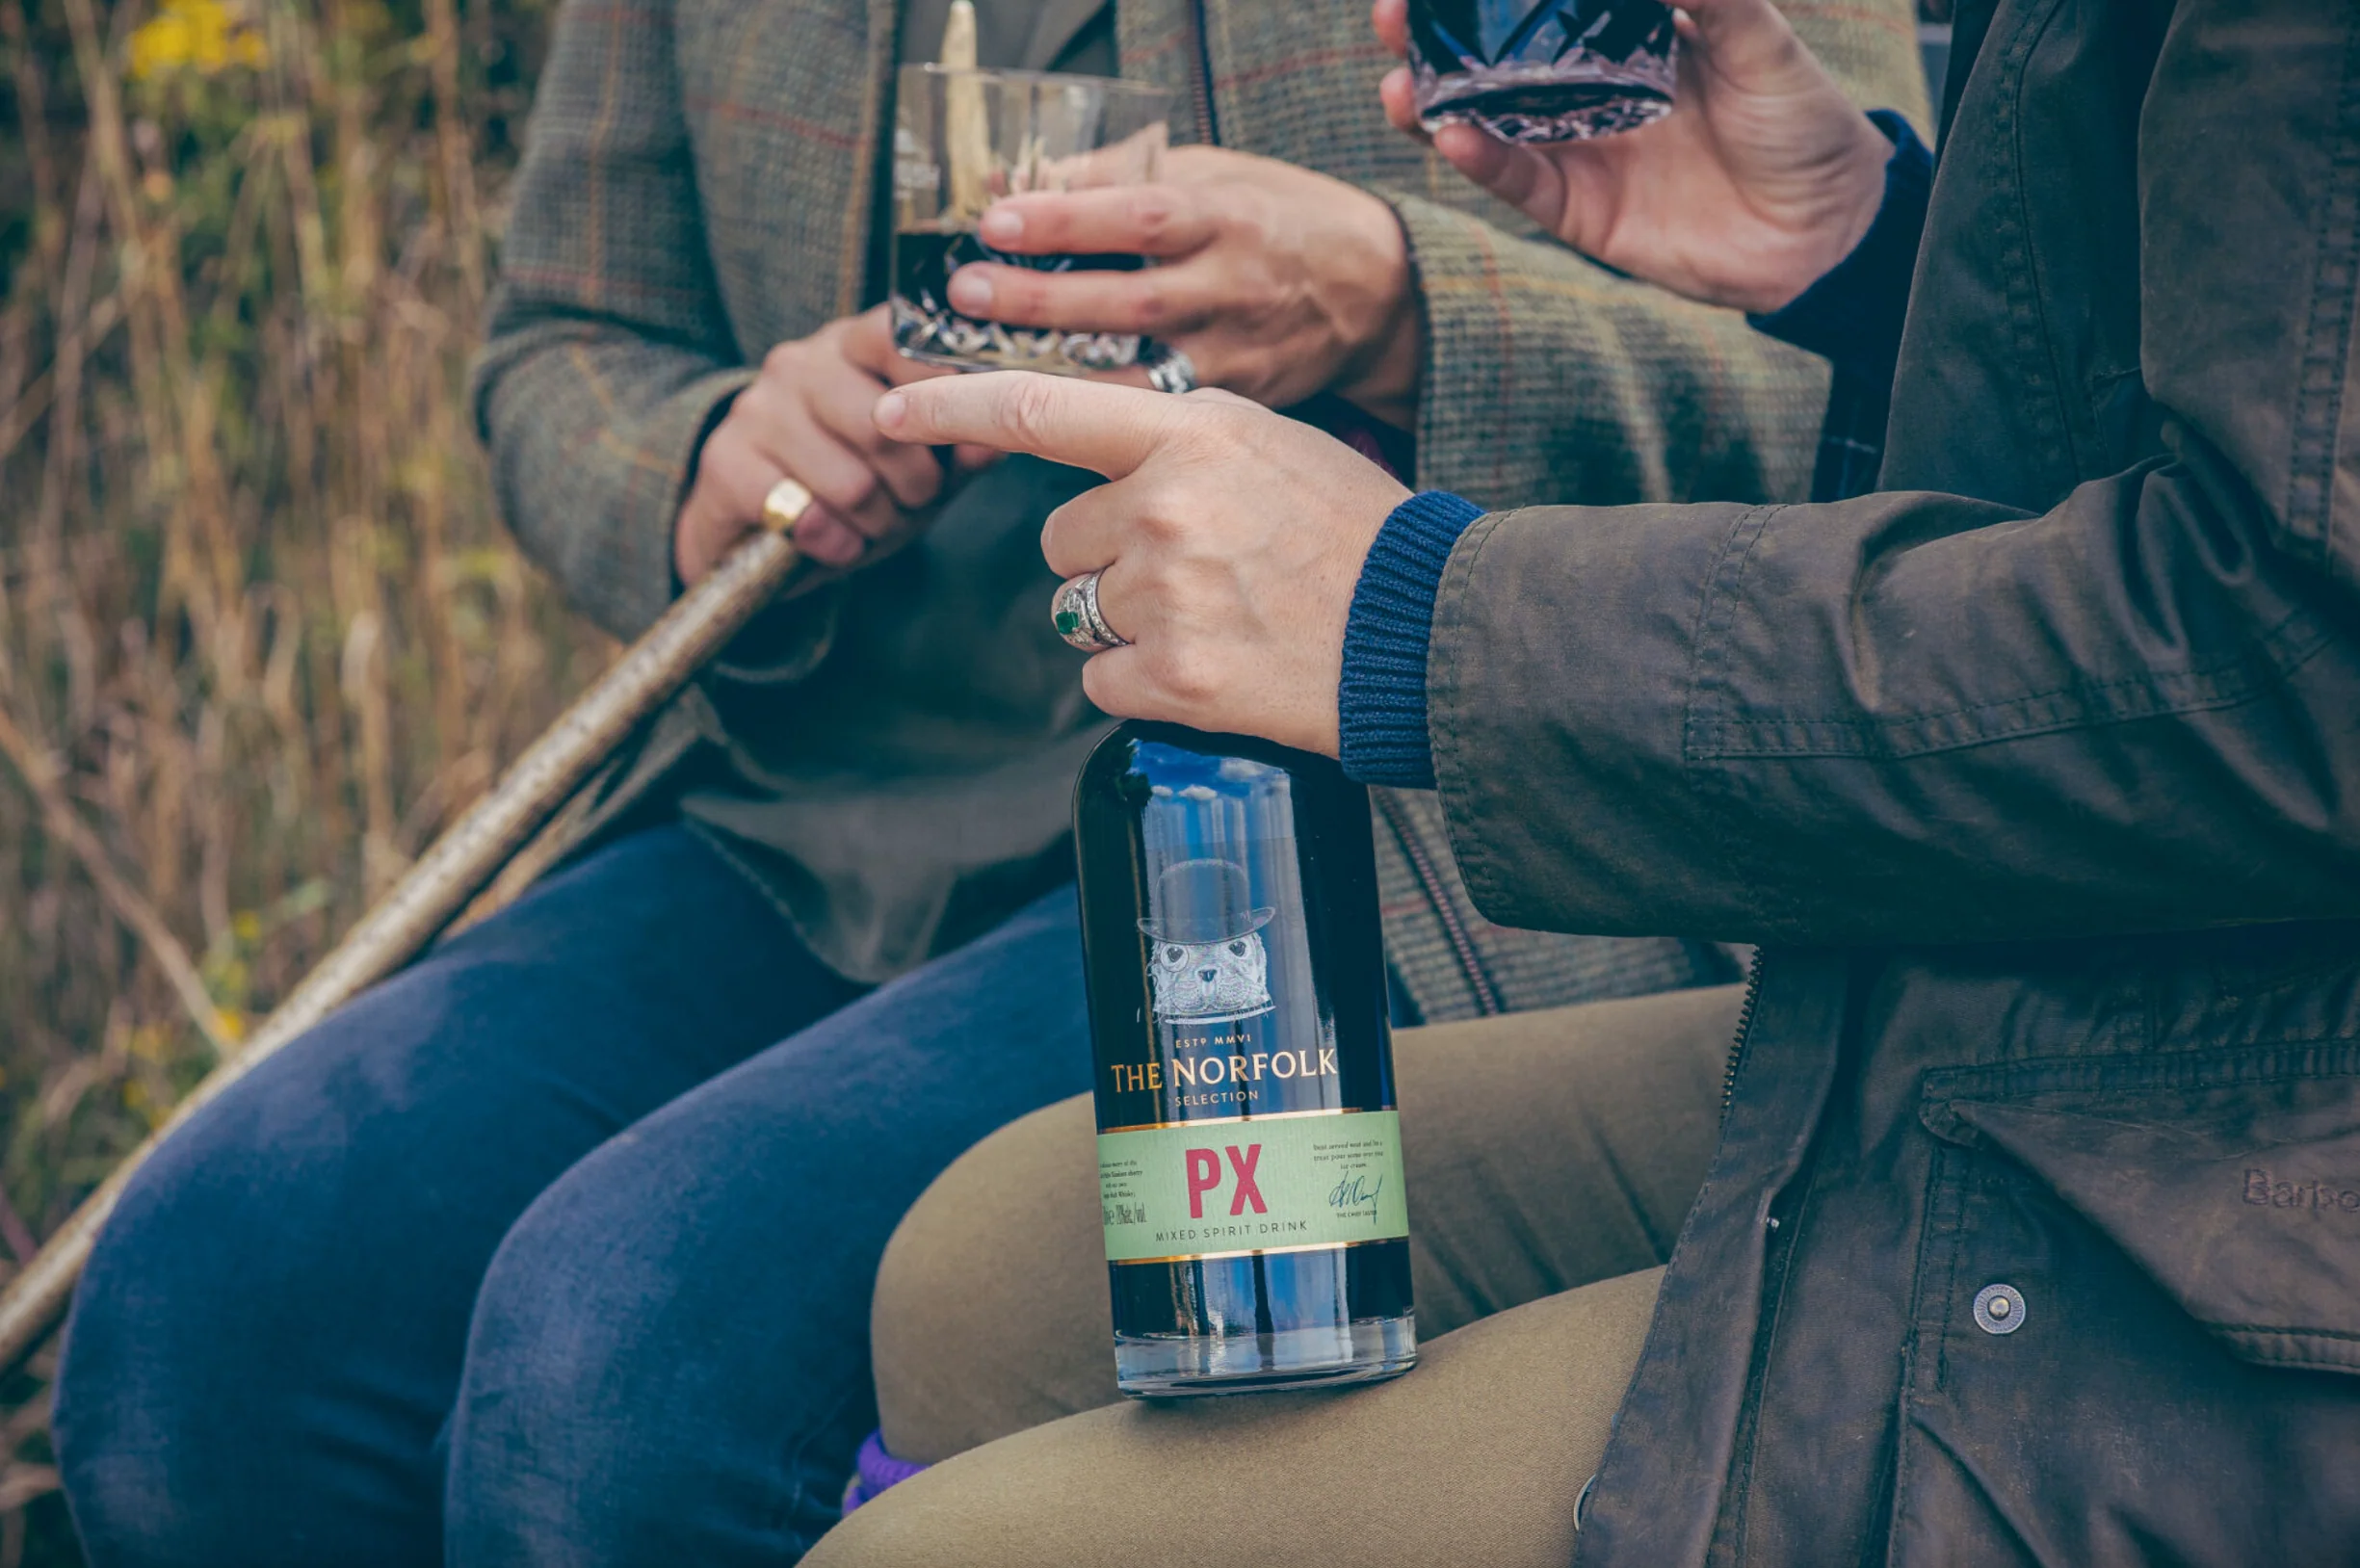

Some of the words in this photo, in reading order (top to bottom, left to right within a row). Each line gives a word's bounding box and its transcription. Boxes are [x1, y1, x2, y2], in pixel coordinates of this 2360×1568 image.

[1215, 1033, 1251, 1045] MMVI
[1111, 1062, 1163, 1092] THE
[1171, 1048, 1338, 1087] NORFOLK
[1175, 1090, 1258, 1107] SELECTION
[1186, 1144, 1268, 1218] PX
[1156, 1229, 1196, 1241] MIXED
[1200, 1224, 1251, 1239] SPIRIT
[1259, 1220, 1307, 1234] DRINK
